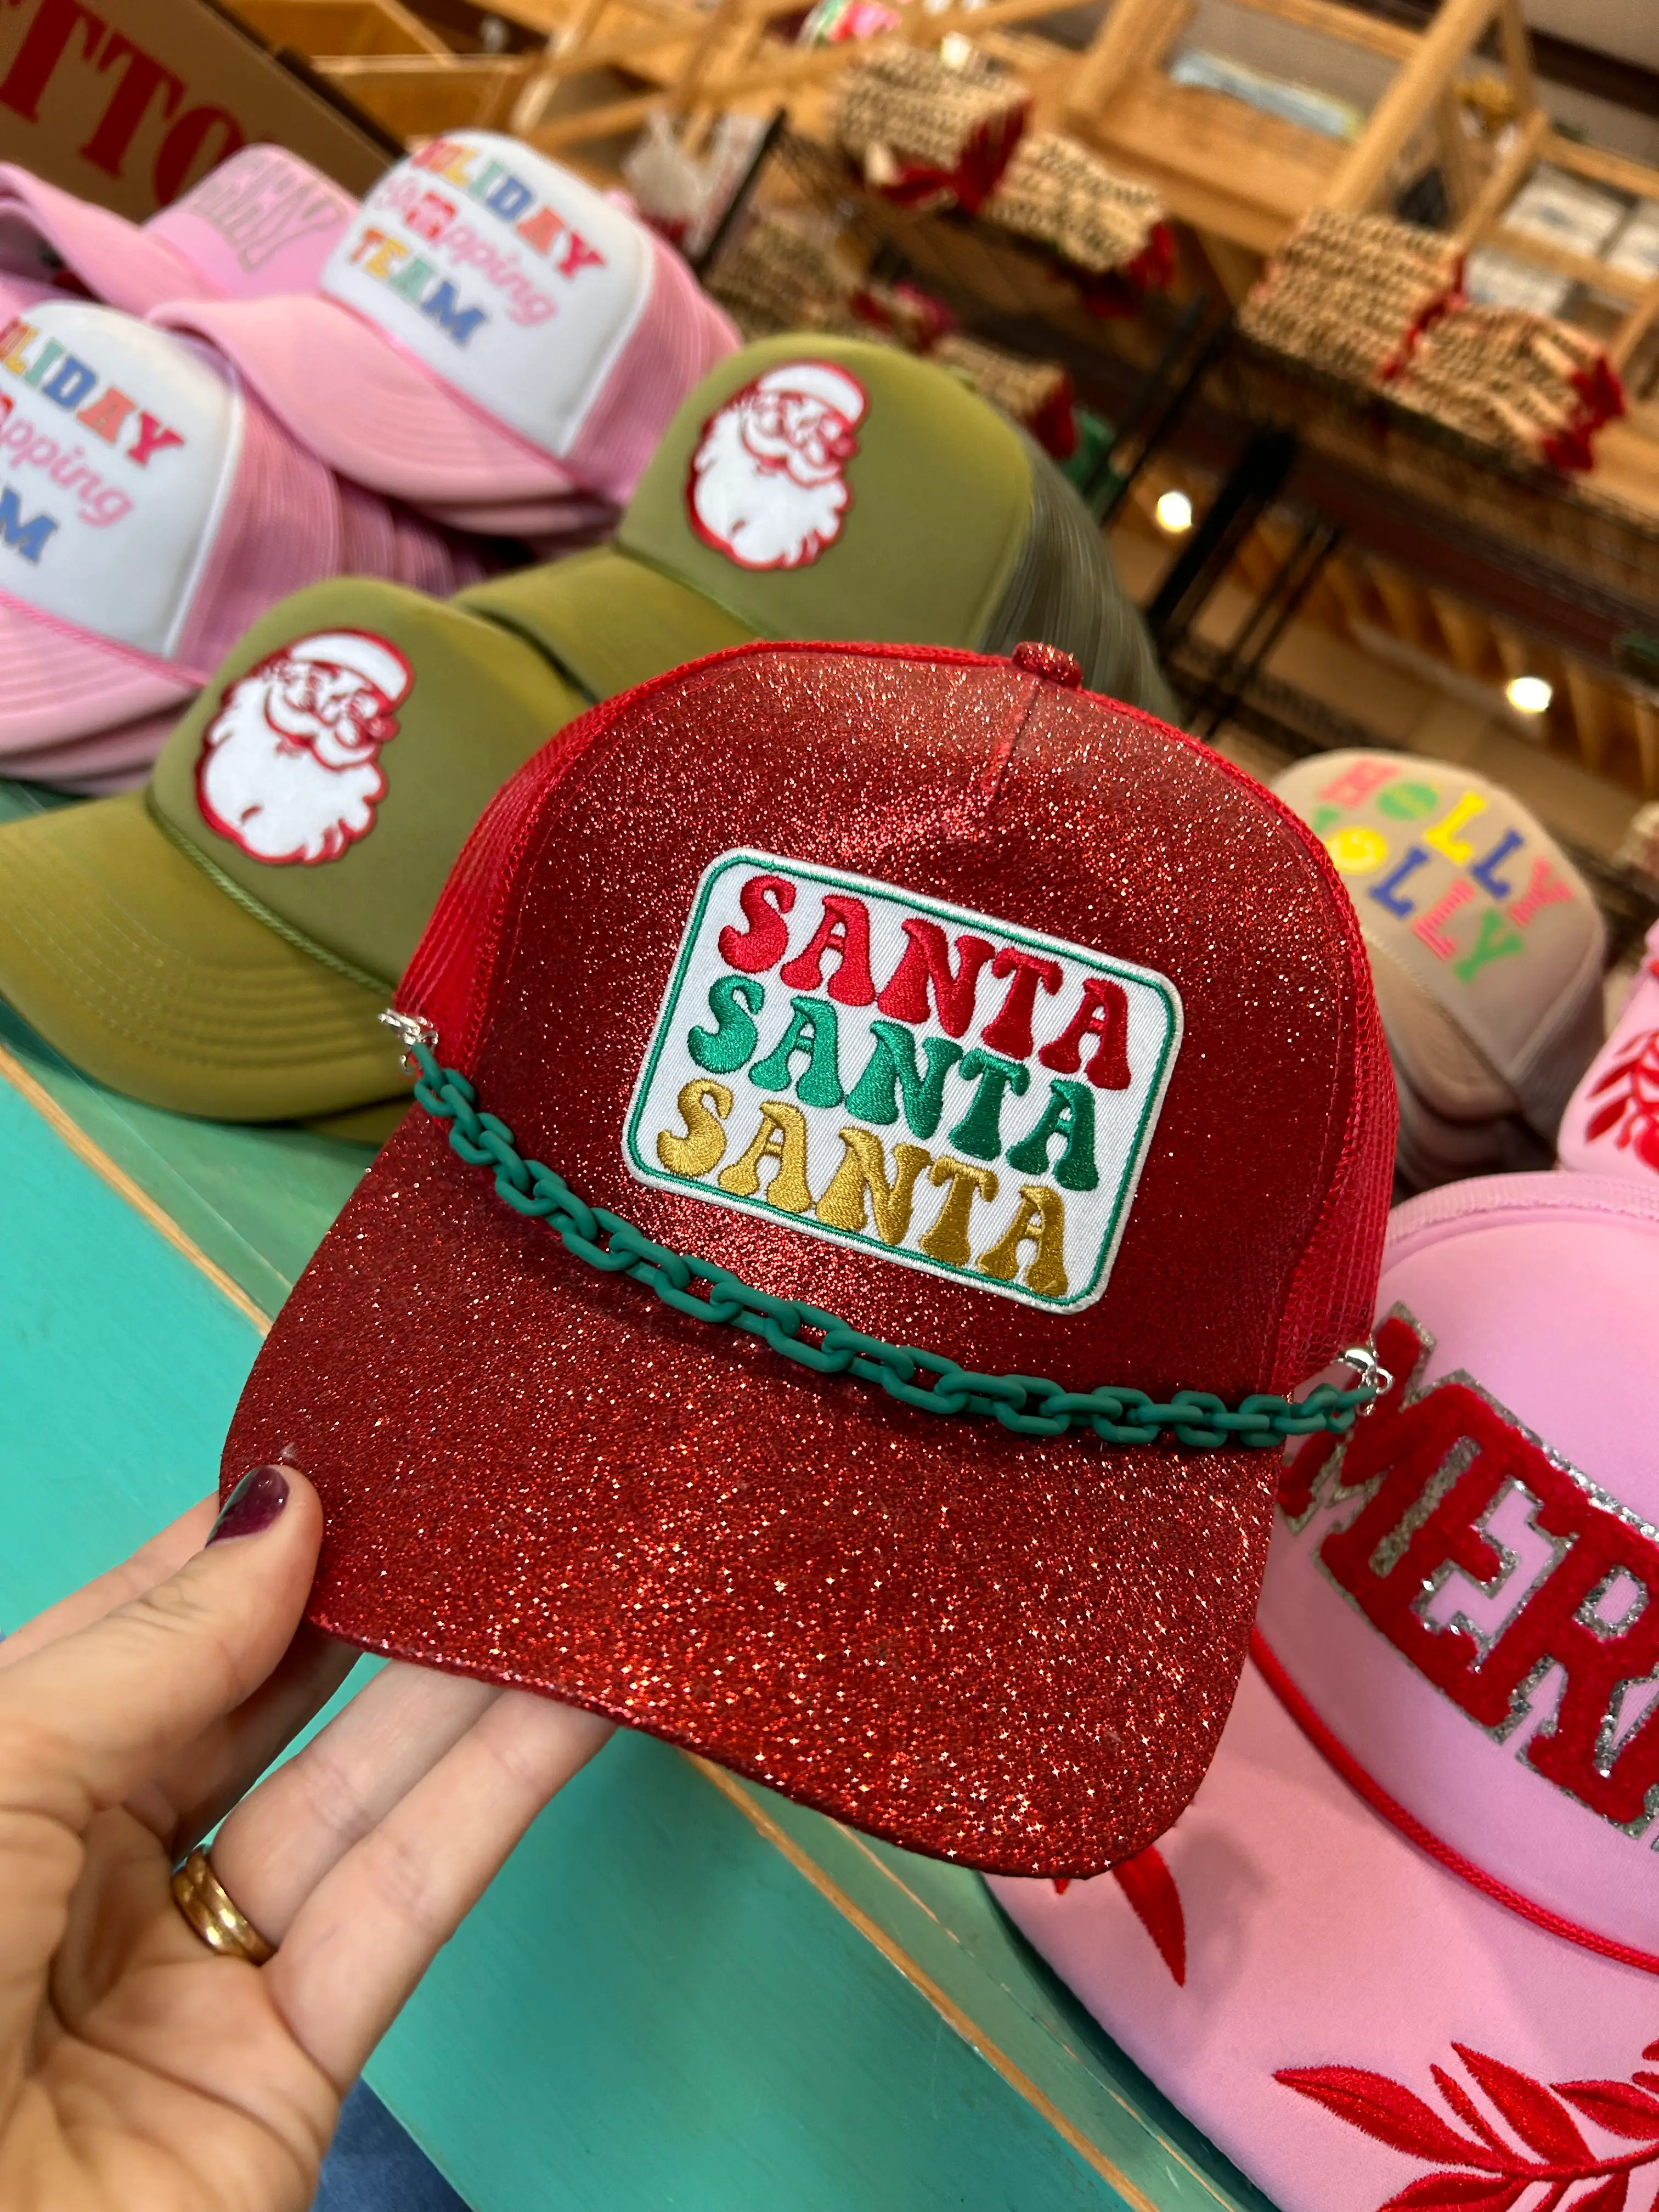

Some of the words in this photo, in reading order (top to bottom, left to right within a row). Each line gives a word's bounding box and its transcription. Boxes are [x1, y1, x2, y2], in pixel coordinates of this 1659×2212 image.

[348, 226, 487, 349] TEAM
[1316, 757, 1576, 928] HOLLY
[687, 974, 1099, 1192] SANTA
[719, 874, 1131, 1091] SANTA
[656, 1077, 1069, 1296] SANTA
